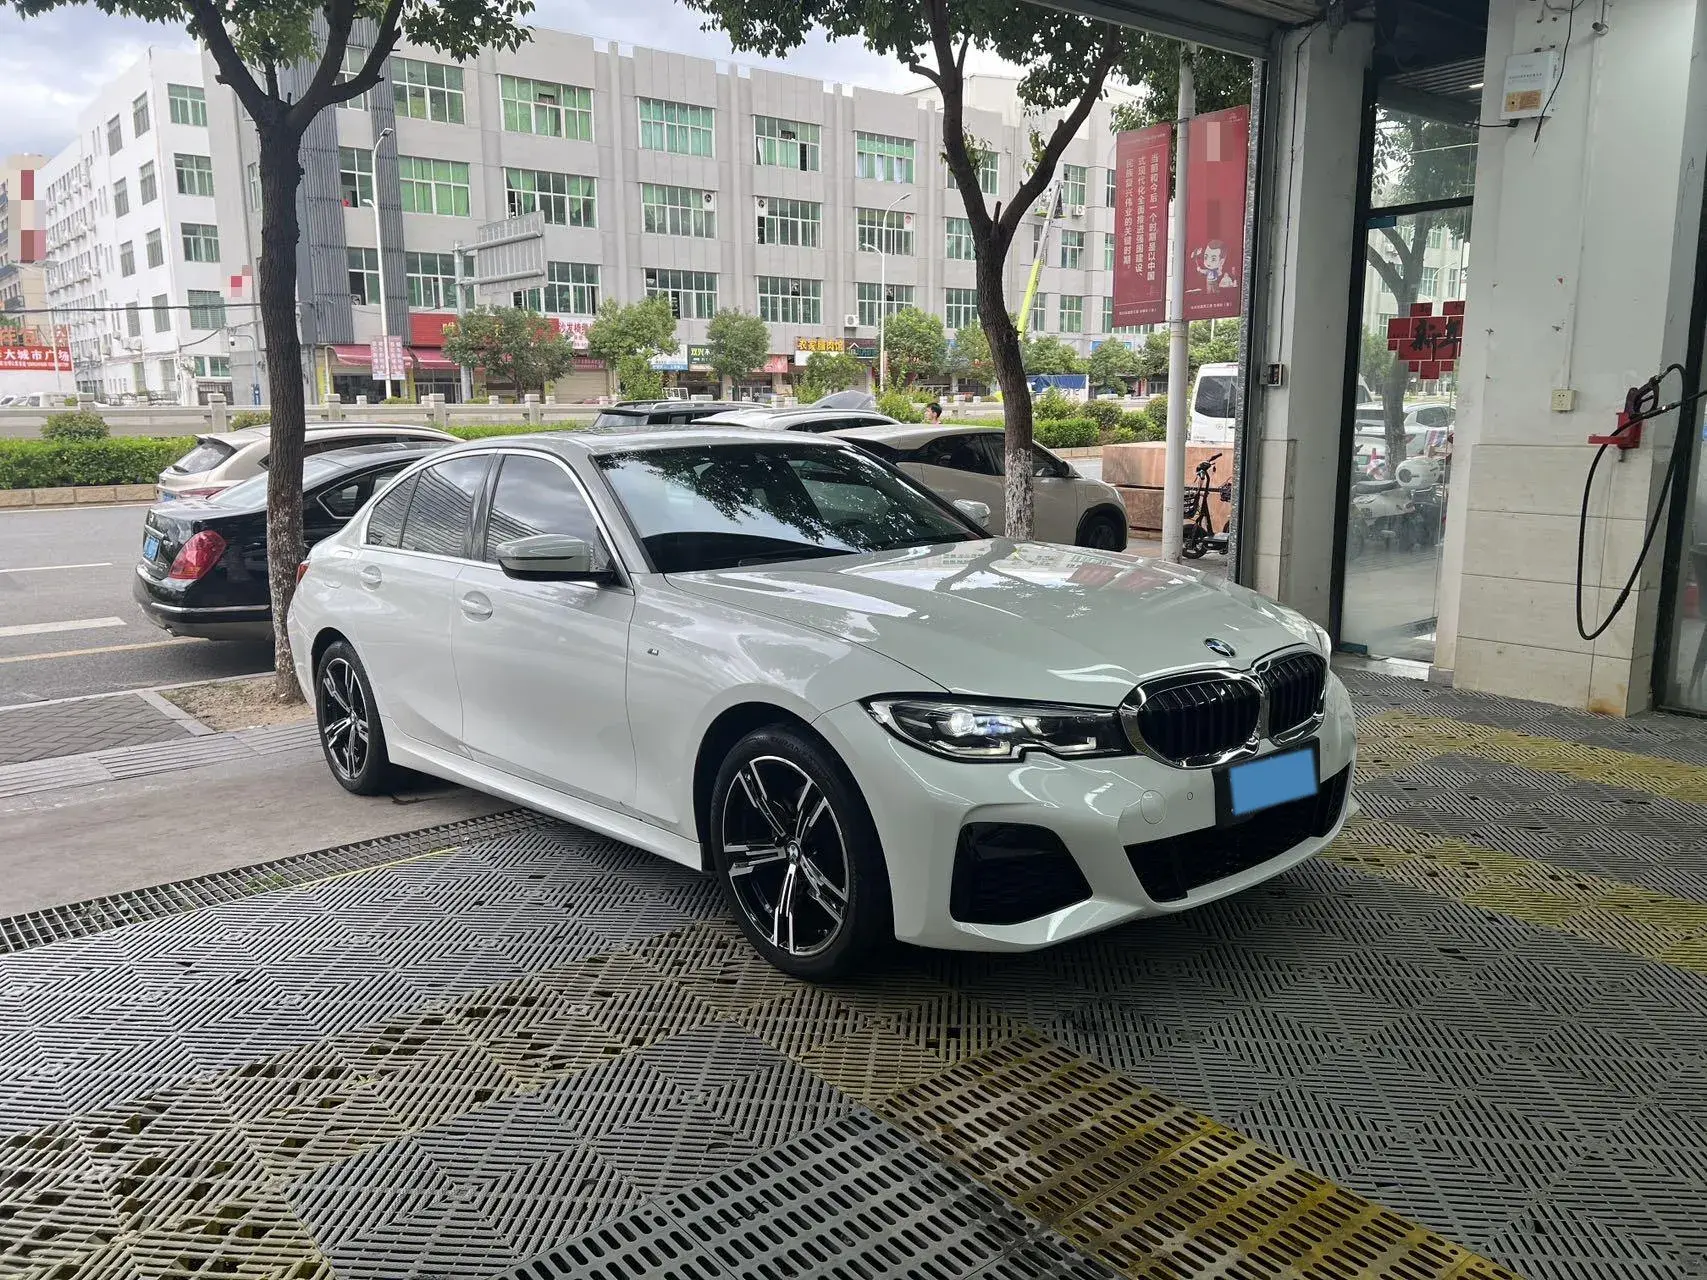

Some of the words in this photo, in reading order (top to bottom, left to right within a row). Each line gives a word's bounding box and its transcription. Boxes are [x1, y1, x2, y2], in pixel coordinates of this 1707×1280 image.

[0, 349, 70, 361] 大城市广场
